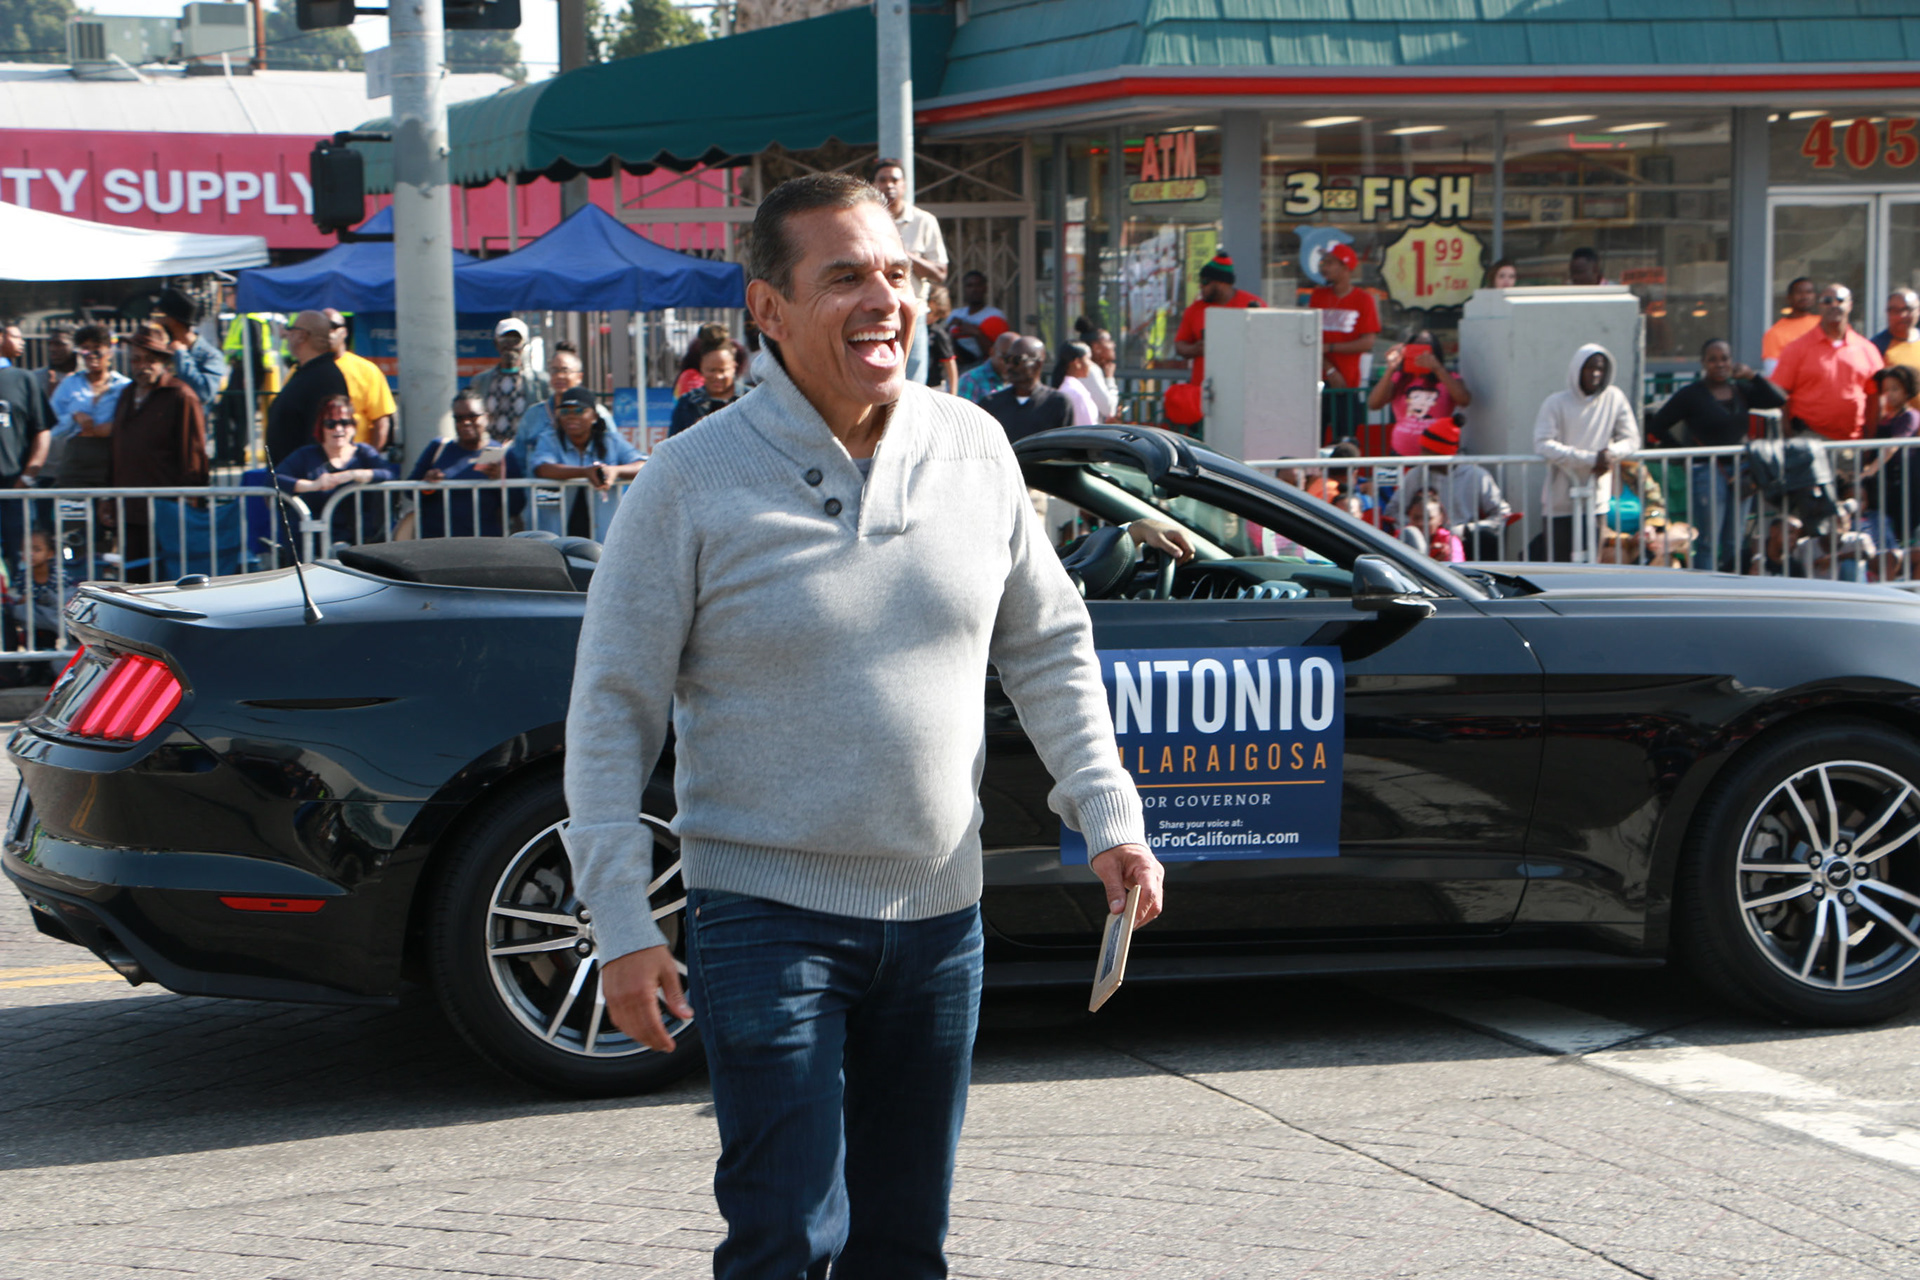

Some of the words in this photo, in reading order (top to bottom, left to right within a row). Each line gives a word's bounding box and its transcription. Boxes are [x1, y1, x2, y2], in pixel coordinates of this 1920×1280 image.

[1141, 131, 1197, 181] ATM
[1801, 117, 1919, 169] 405
[103, 168, 314, 215] SUPPLY
[1285, 171, 1322, 215] 3
[1362, 175, 1472, 221] FISH
[1114, 656, 1335, 734] NTONIO
[1118, 742, 1327, 773] LLARAIGOSA
[1142, 796, 1168, 808] OR
[1174, 793, 1272, 808] GOVERNOR
[1147, 831, 1299, 849] ioForCalifornia.com
[1159, 820, 1184, 829] Share
[1186, 822, 1206, 831] your
[1207, 819, 1230, 828] voice
[1231, 818, 1244, 828] at:
